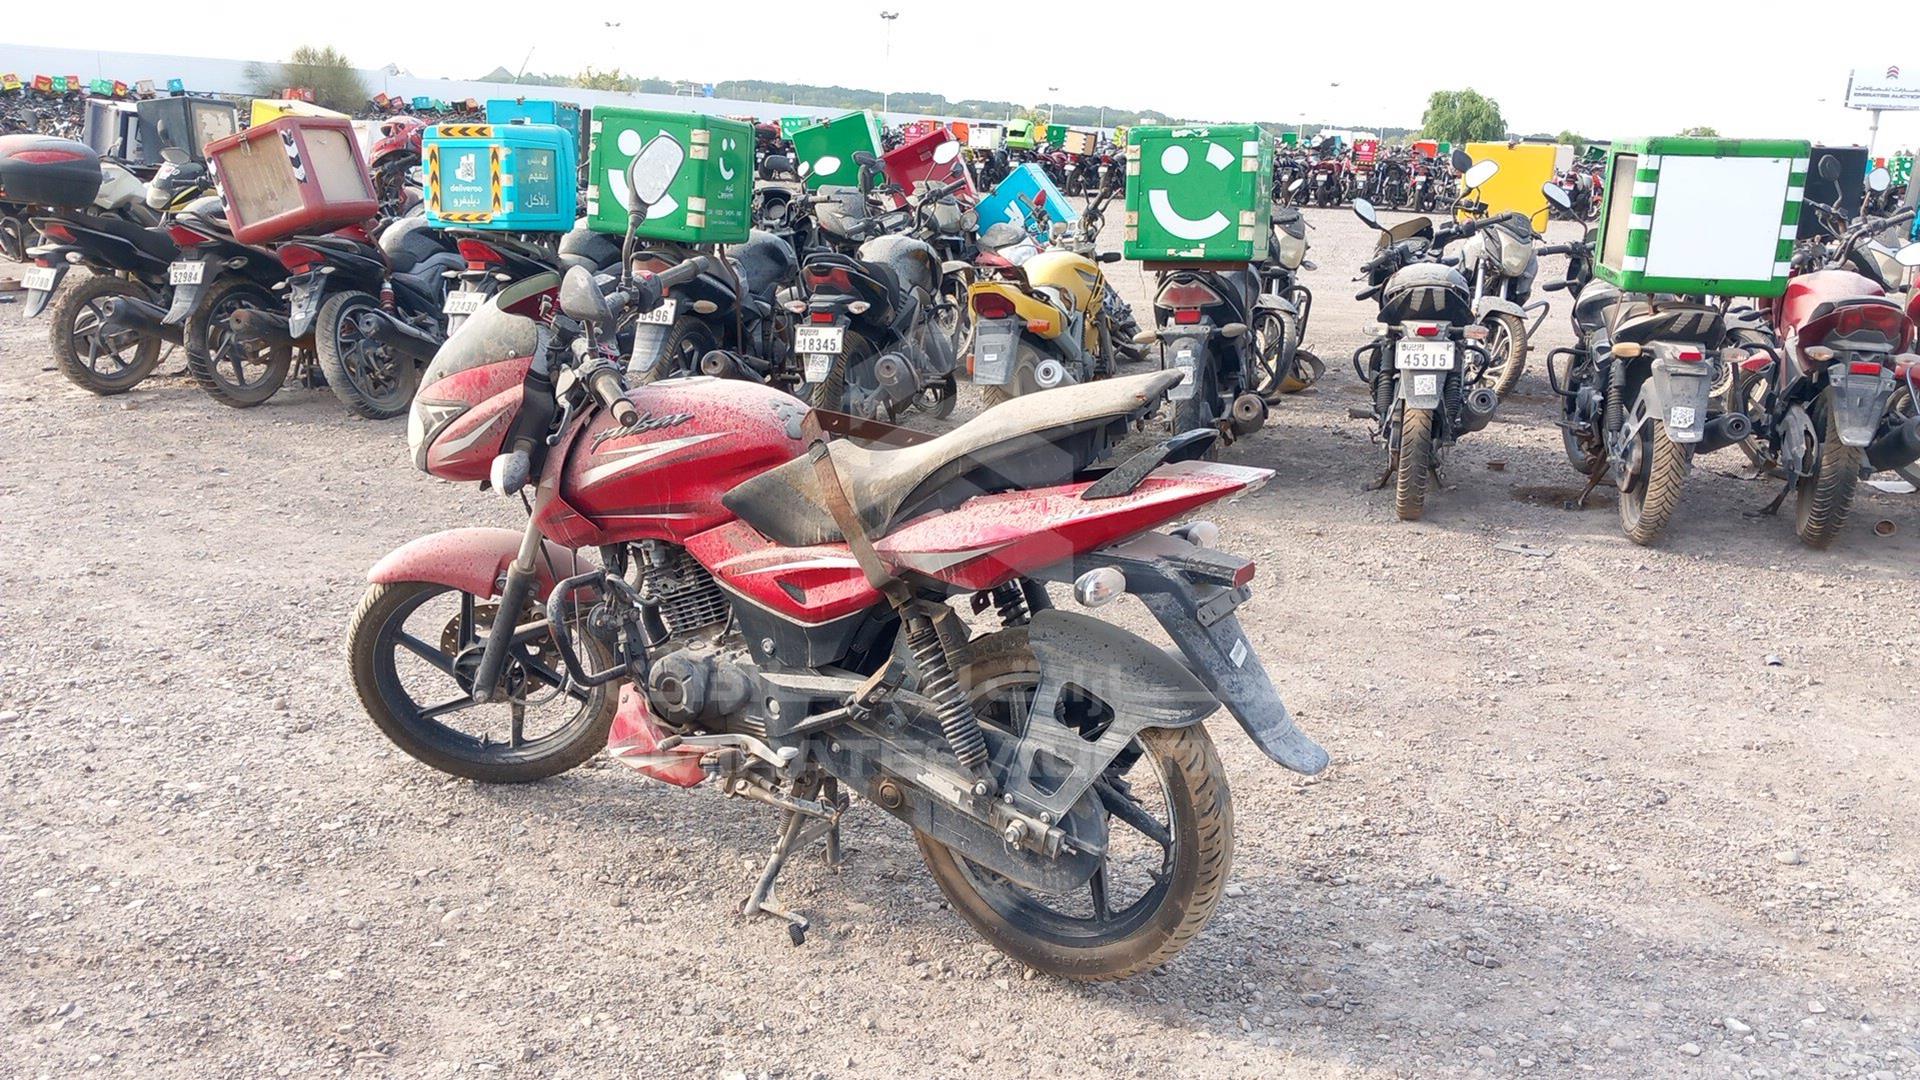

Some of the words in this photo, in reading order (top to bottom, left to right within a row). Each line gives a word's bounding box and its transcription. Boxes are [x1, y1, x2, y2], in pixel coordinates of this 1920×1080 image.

[450, 184, 483, 192] deliveroo
[173, 271, 198, 283] 52984
[448, 301, 478, 312] 22430
[802, 338, 836, 351] 18345
[1403, 353, 1446, 367] 45315
